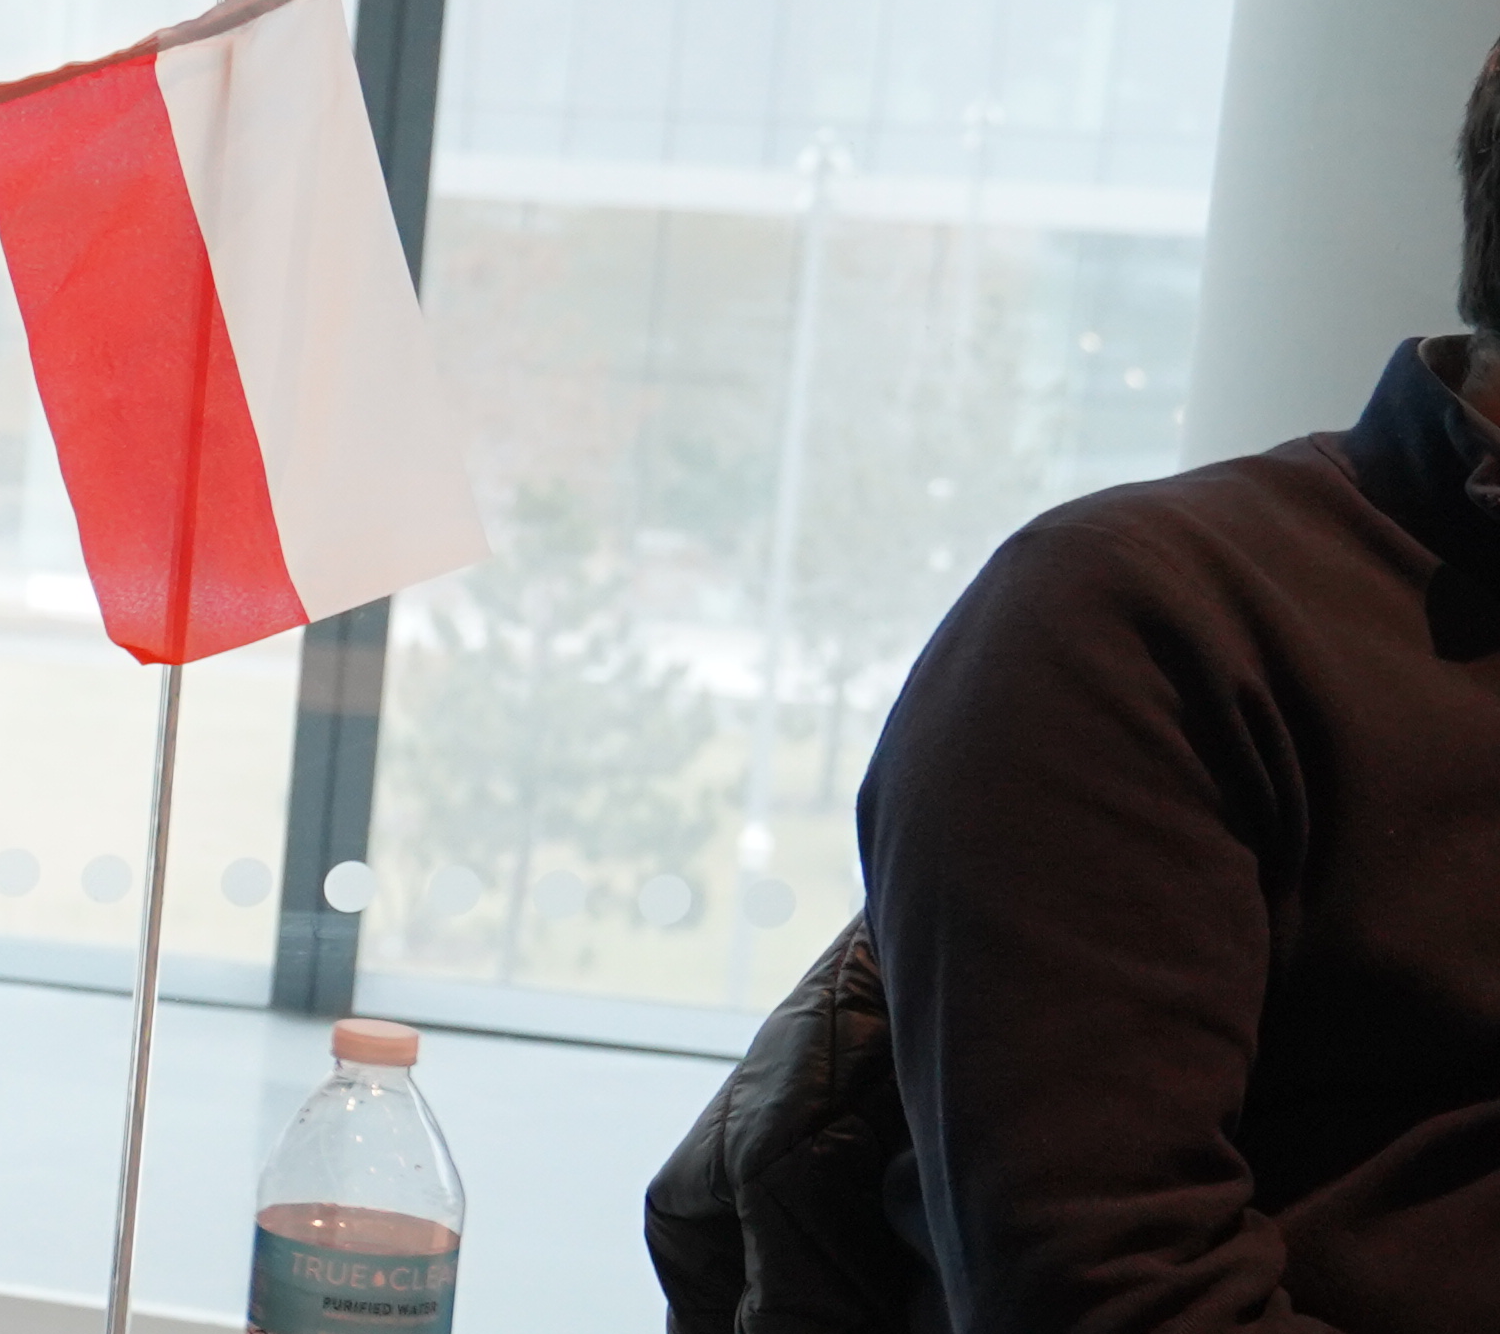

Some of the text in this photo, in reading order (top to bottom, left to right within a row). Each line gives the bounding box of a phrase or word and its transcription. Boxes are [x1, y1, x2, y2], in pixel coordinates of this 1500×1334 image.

[292, 1252, 367, 1290] TRUE
[323, 1297, 438, 1316] PURIFIED WATER
